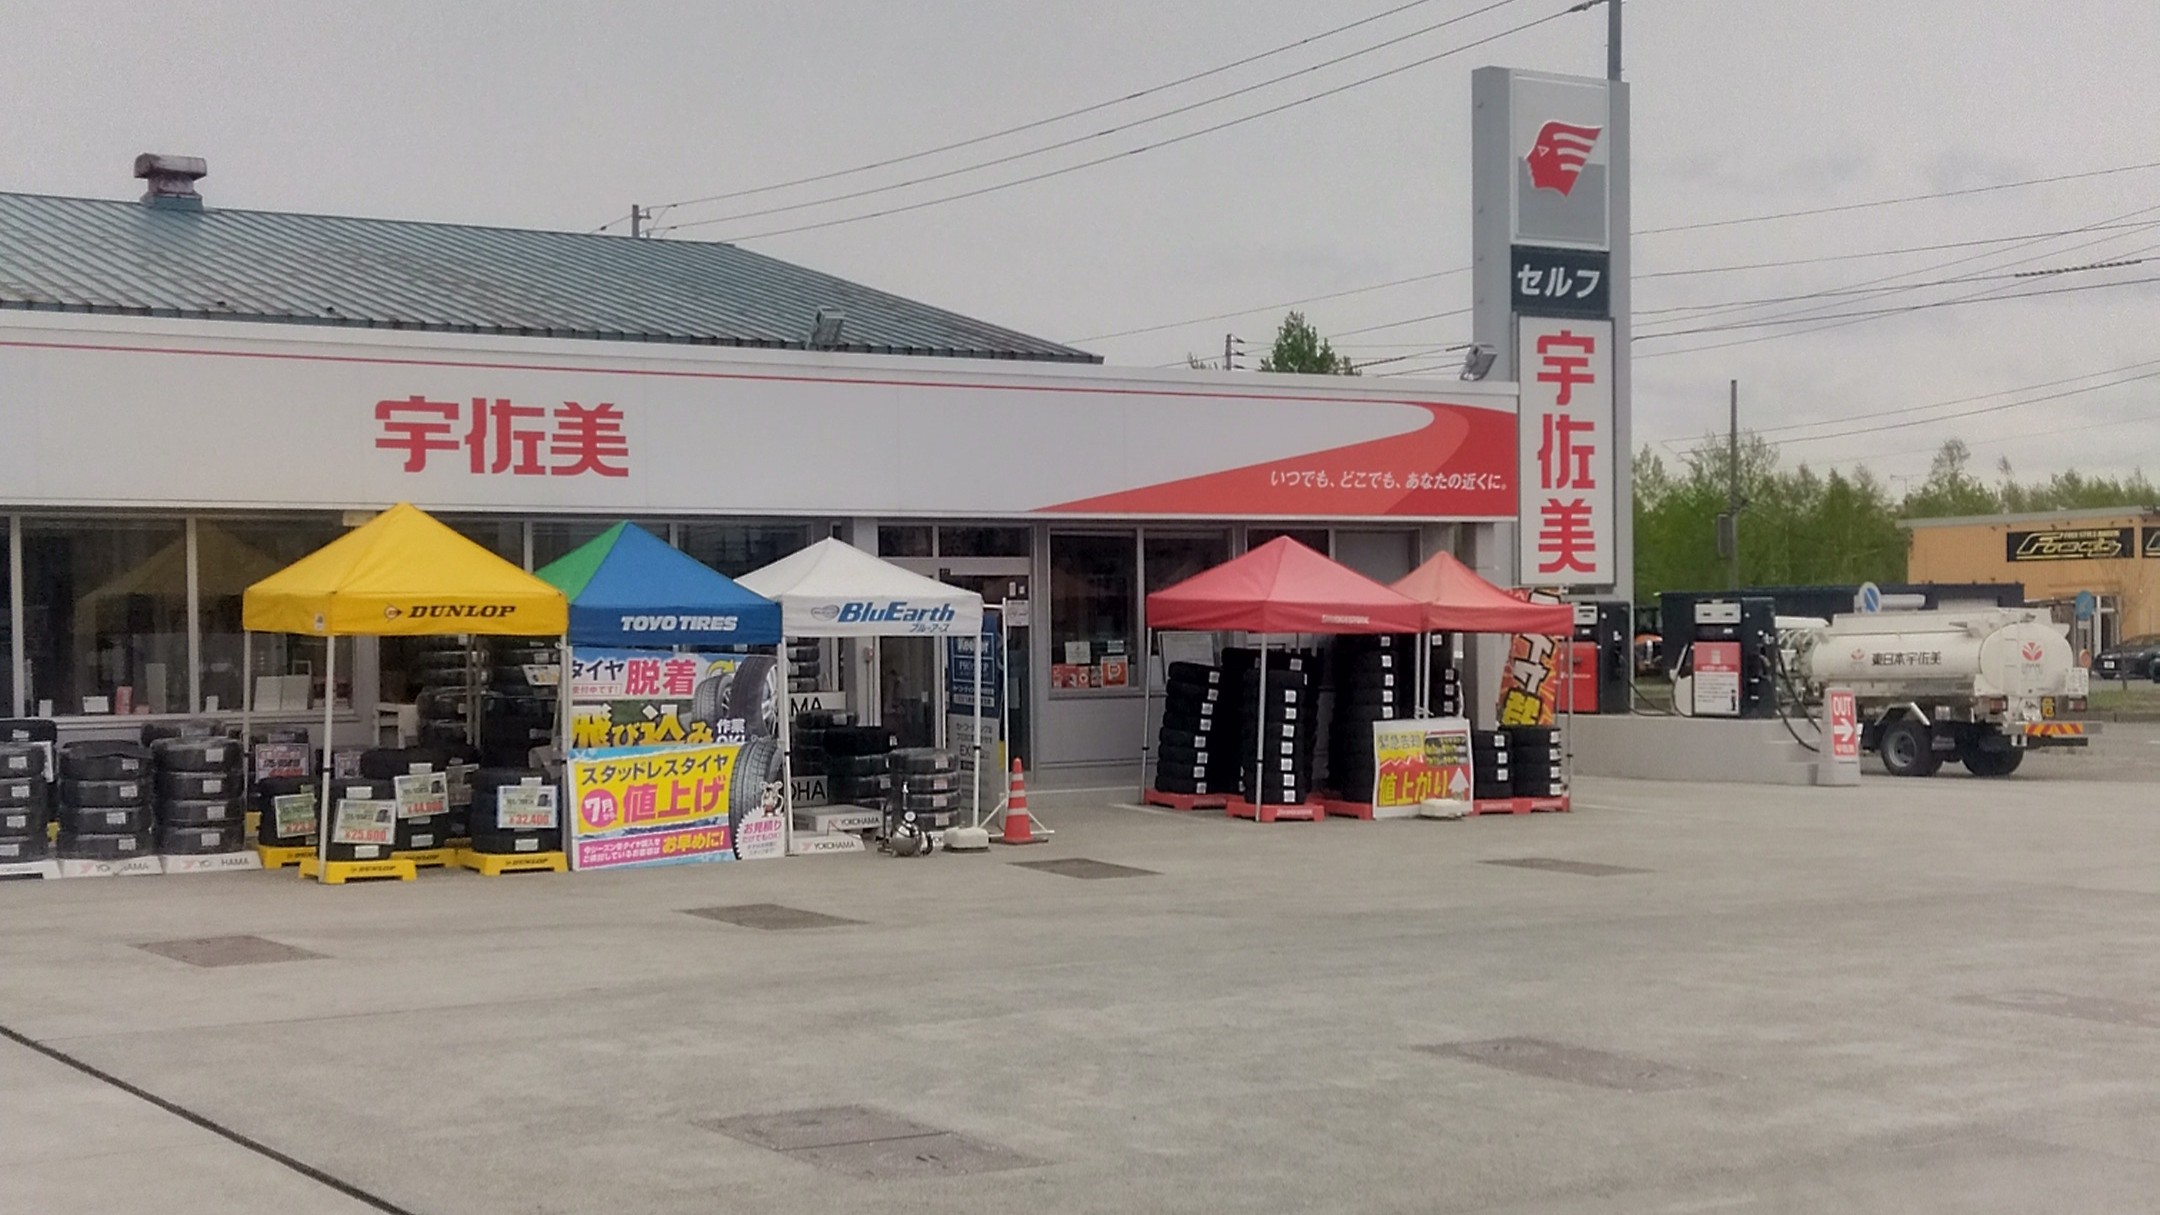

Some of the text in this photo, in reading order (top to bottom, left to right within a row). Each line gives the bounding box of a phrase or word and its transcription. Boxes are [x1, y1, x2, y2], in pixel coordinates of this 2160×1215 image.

[1517, 263, 1600, 299] セルフ
[375, 395, 629, 477] 宇佐美
[1537, 330, 1596, 574] 宇佐美
[1270, 470, 1507, 490] いつでも、どこでも、あなたの近くに。
[408, 605, 516, 618] DUNLOP
[838, 601, 955, 622] BluEarth
[620, 615, 739, 631] TOYO TIRES
[1833, 696, 1852, 716] OUT
[581, 753, 728, 786] スタッドレスタイヤ
[623, 773, 727, 824] 値上げ
[1378, 769, 1448, 806] 値上がり
[840, 816, 880, 825] YOKOHAMA
[662, 831, 725, 854] お早めに!
[814, 841, 855, 850] YOKOHAMA
